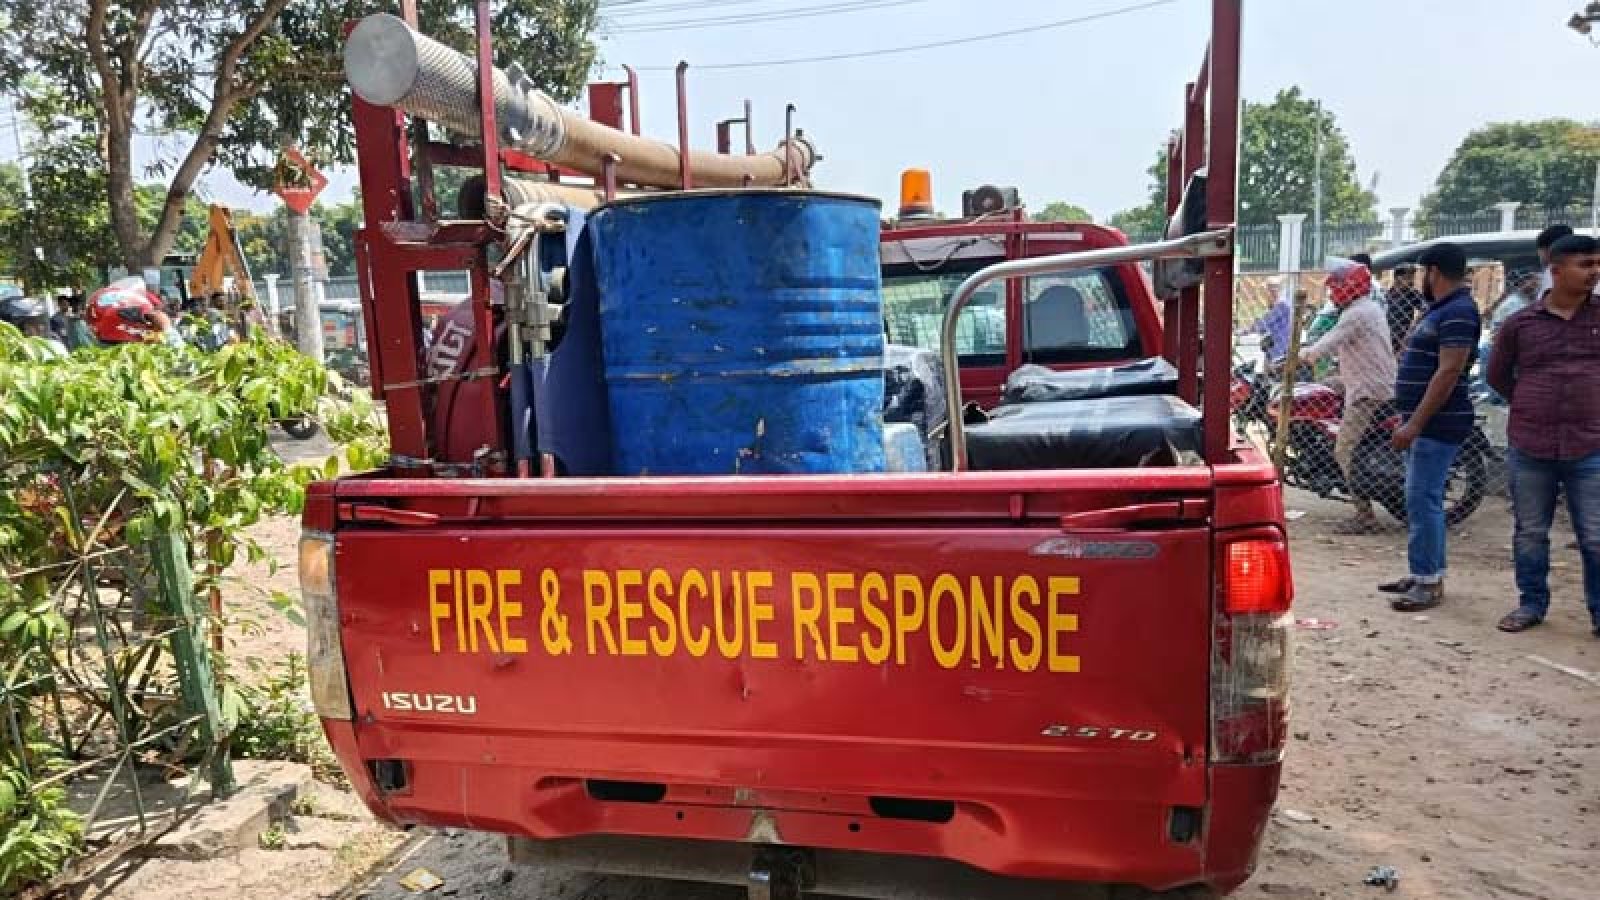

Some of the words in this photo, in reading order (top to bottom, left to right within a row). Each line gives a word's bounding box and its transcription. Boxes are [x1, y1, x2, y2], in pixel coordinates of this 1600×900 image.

[429, 569, 528, 652] FIRE
[539, 568, 573, 655] &
[583, 569, 779, 658] RESCUE
[791, 571, 1081, 672] RESPONSE
[382, 691, 477, 713] ISUZU
[1108, 727, 1158, 740] TD
